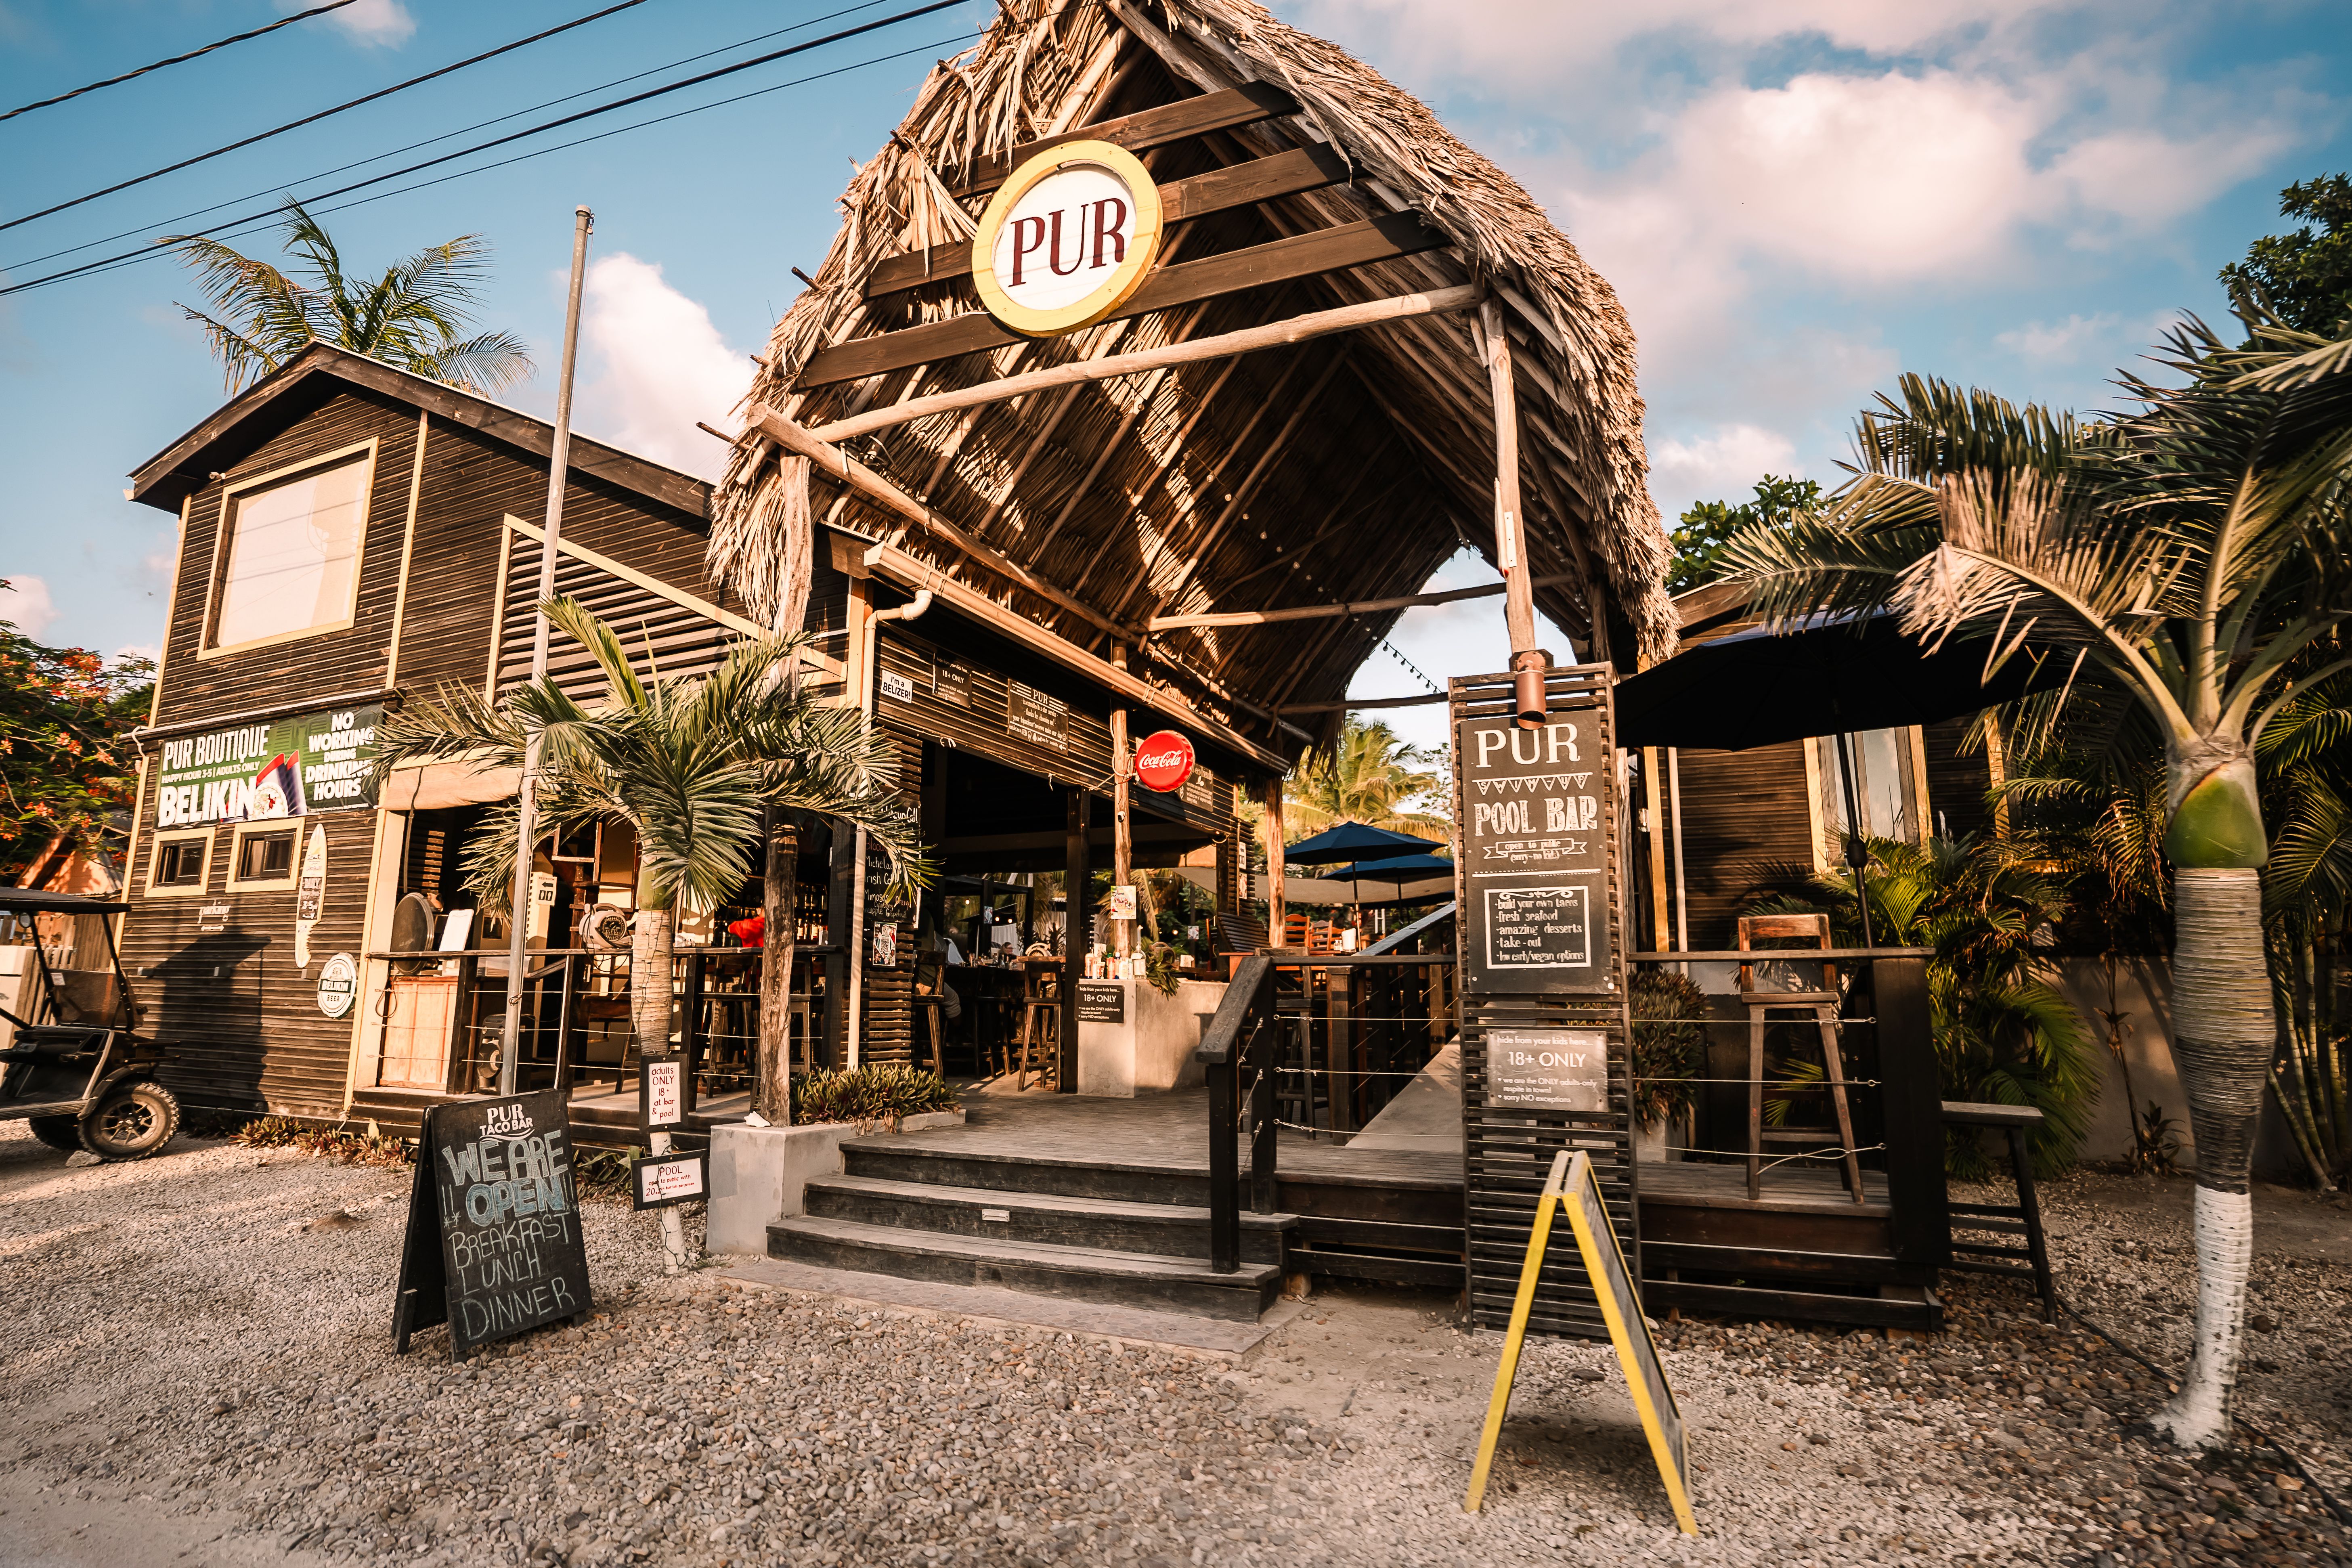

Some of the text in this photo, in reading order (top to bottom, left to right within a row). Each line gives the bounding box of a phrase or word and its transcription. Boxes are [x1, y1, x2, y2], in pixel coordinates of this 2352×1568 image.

[1008, 198, 1126, 287] PUR
[942, 670, 964, 683] 18+ ONLY
[883, 682, 910, 700] BELIZER!
[1033, 689, 1048, 704] PUR
[331, 711, 354, 732] NO
[163, 725, 270, 771] PUR BOUTIQUE
[309, 726, 375, 753] WORKING
[1474, 723, 1581, 768] PUR
[323, 748, 356, 763] DURING
[1139, 750, 1183, 769] Coca-Cola
[161, 761, 260, 783] HAPPY HOUR 3-5 ADULTS ONLY
[305, 759, 373, 783] DRINKING
[314, 778, 361, 801] HOURS
[1480, 776, 1584, 790] SWIM-UP
[158, 776, 257, 827] BELIKIN
[1474, 796, 1597, 836] POOL BAR
[1505, 842, 1524, 851] open
[197, 898, 231, 924] parking
[886, 908, 907, 919] Grapefruit
[1517, 900, 1534, 912] your
[1555, 898, 1578, 908] tacos
[1499, 909, 1558, 922] fresh seafood
[1499, 922, 1582, 935] amazing desserts
[1499, 950, 1510, 961] low
[1557, 950, 1584, 962] options
[321, 980, 349, 992] BELIKIN
[1497, 1036, 1513, 1046] hide
[1515, 1036, 1532, 1044] from
[1533, 1038, 1551, 1046] your
[1552, 1037, 1568, 1046] kids
[1508, 1051, 1587, 1068] 18+ ONLY
[652, 1067, 674, 1075] adults
[653, 1075, 674, 1085] ONLY
[1560, 1078, 1597, 1088] adults-only
[1535, 1096, 1572, 1104] exceptions
[486, 1103, 524, 1124] PUR
[660, 1108, 673, 1121] pool
[480, 1117, 533, 1136] TACO BAR
[442, 1129, 568, 1186] WE ARE
[659, 1165, 683, 1176] POOL
[646, 1188, 655, 1196] 20
[448, 1212, 570, 1275] BREAKFAST
[461, 1241, 541, 1295] LUNCH
[461, 1277, 575, 1340] DINNER
